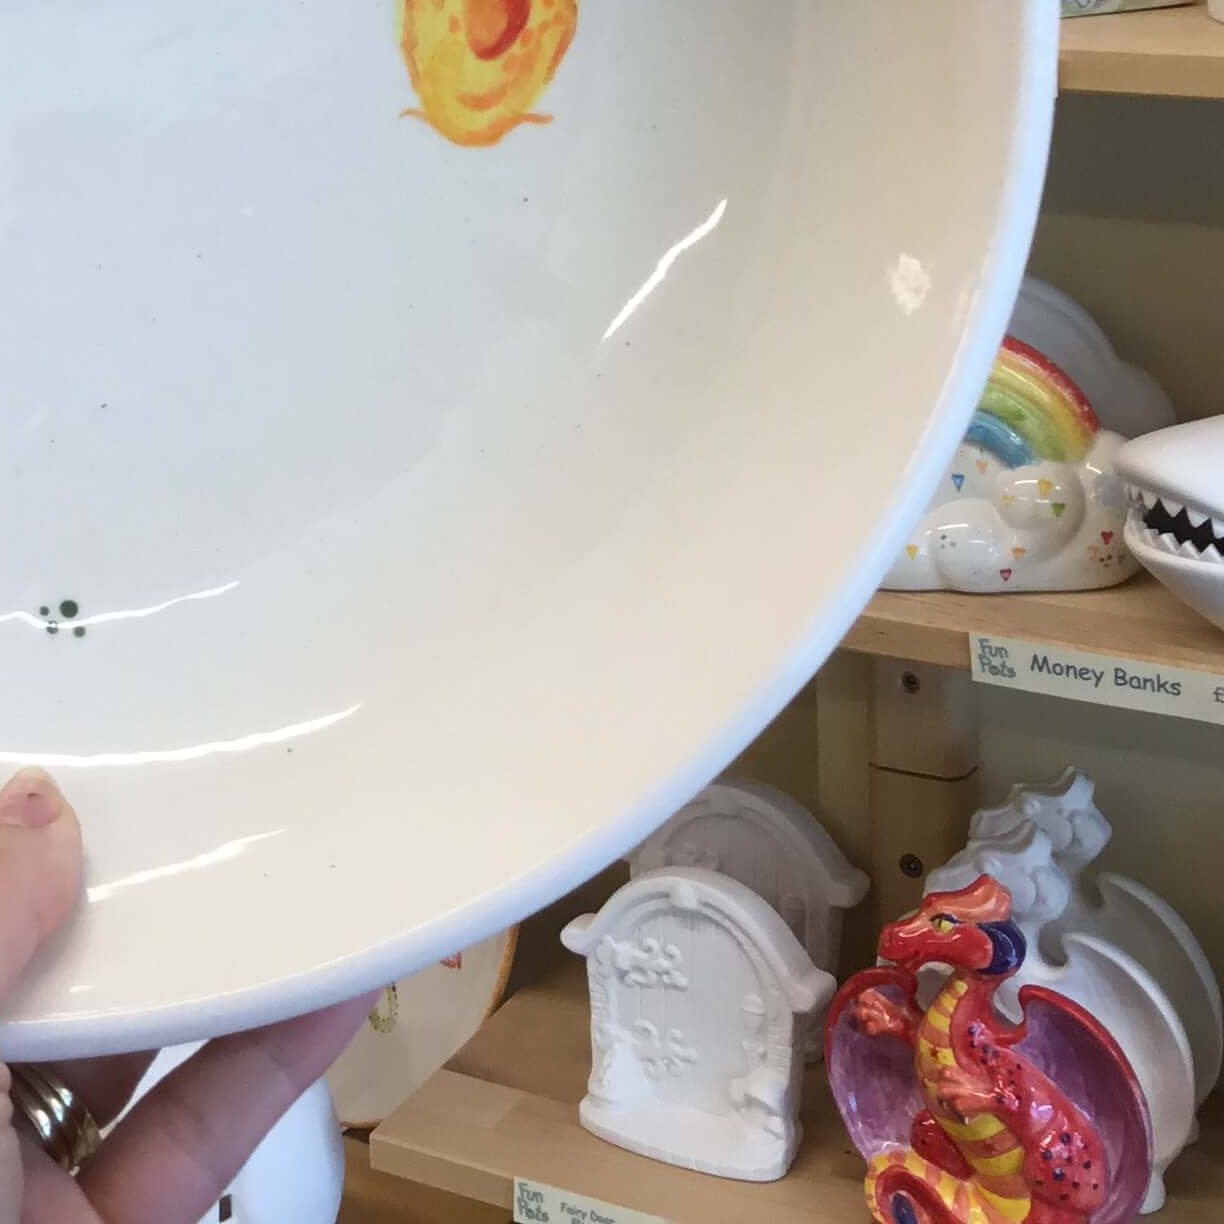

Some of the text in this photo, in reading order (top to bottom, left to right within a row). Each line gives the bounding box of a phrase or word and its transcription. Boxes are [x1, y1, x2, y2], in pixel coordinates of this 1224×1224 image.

[979, 638, 1009, 659] Fun
[978, 654, 1016, 679] Pots
[1030, 653, 1105, 688] Money
[1113, 667, 1182, 697] Banks
[517, 1182, 544, 1204] Fun
[516, 1196, 550, 1223] Pots
[560, 1202, 588, 1220] Fairy
